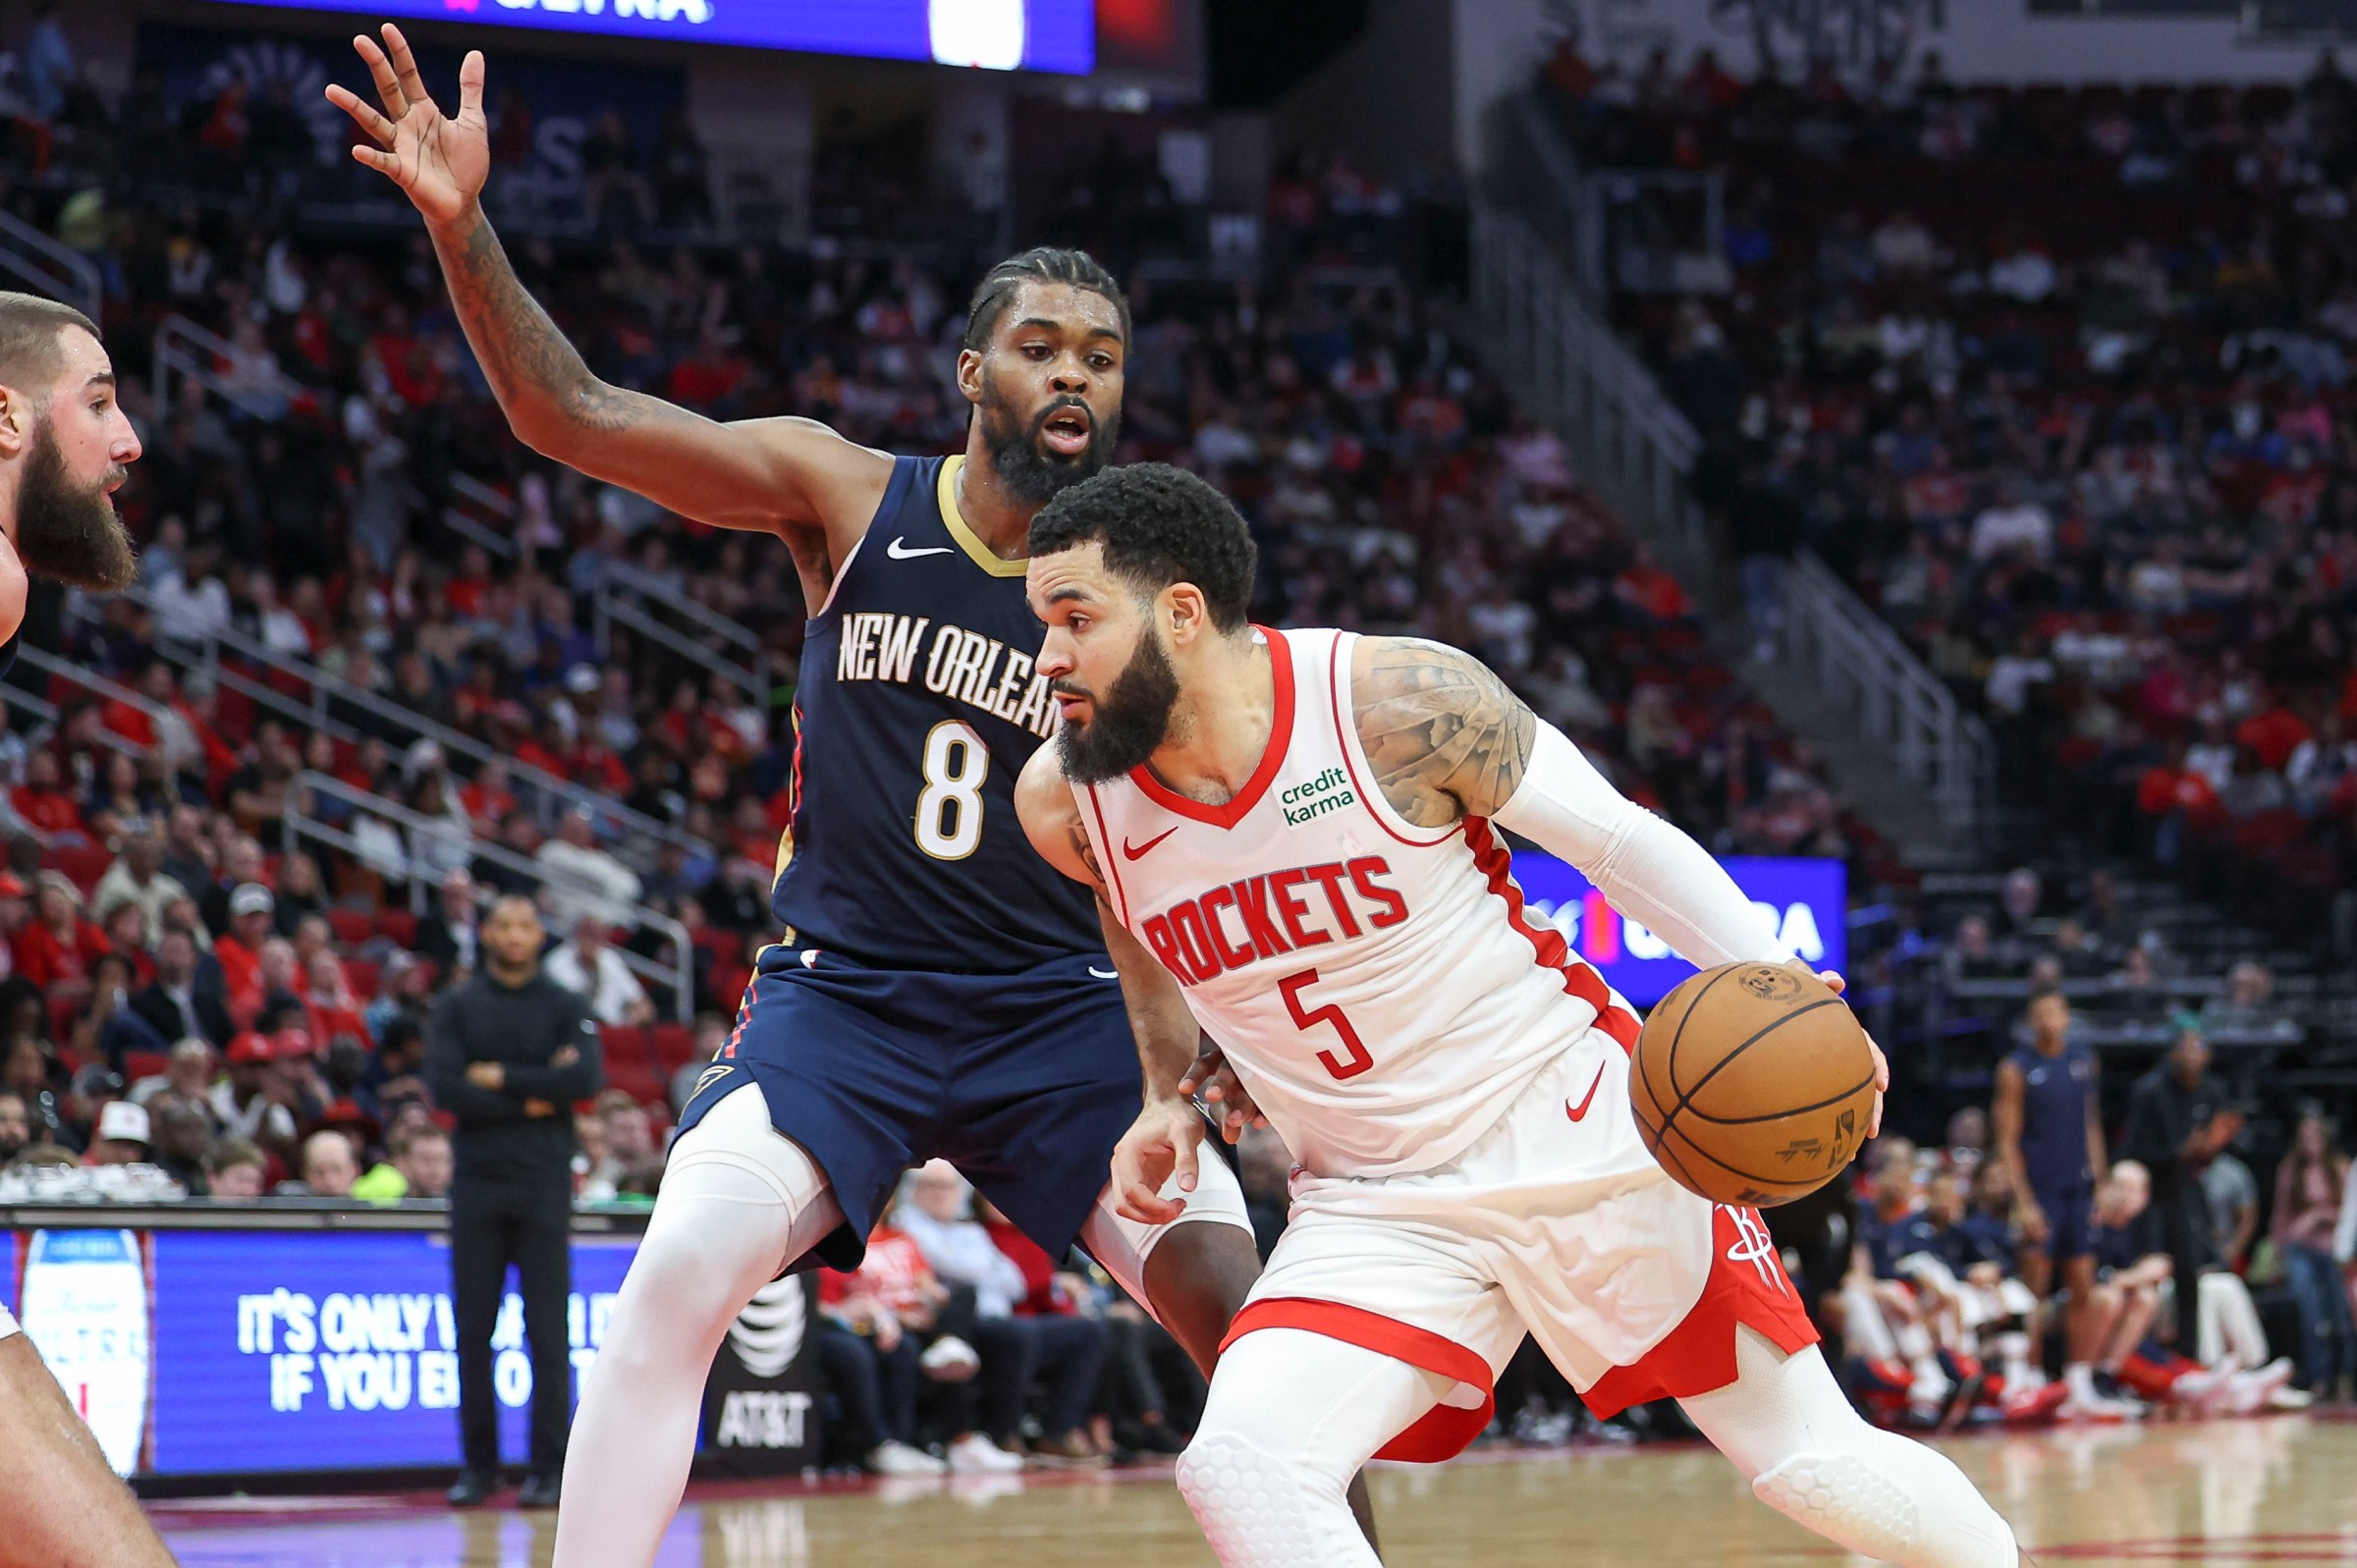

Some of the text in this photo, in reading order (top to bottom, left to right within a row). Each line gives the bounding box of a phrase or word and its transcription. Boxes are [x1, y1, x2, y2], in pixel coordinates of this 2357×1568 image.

[837, 613, 930, 682] NEW
[914, 719, 990, 861] 8
[1282, 768, 1346, 804] credit
[1283, 790, 1354, 826] karma
[1141, 855, 1409, 987] ROCKETS
[1277, 968, 1373, 1080] 5
[237, 1286, 316, 1354] IT'S
[320, 1292, 433, 1352] ONLY
[270, 1351, 314, 1412] IF
[318, 1351, 411, 1411] YOU
